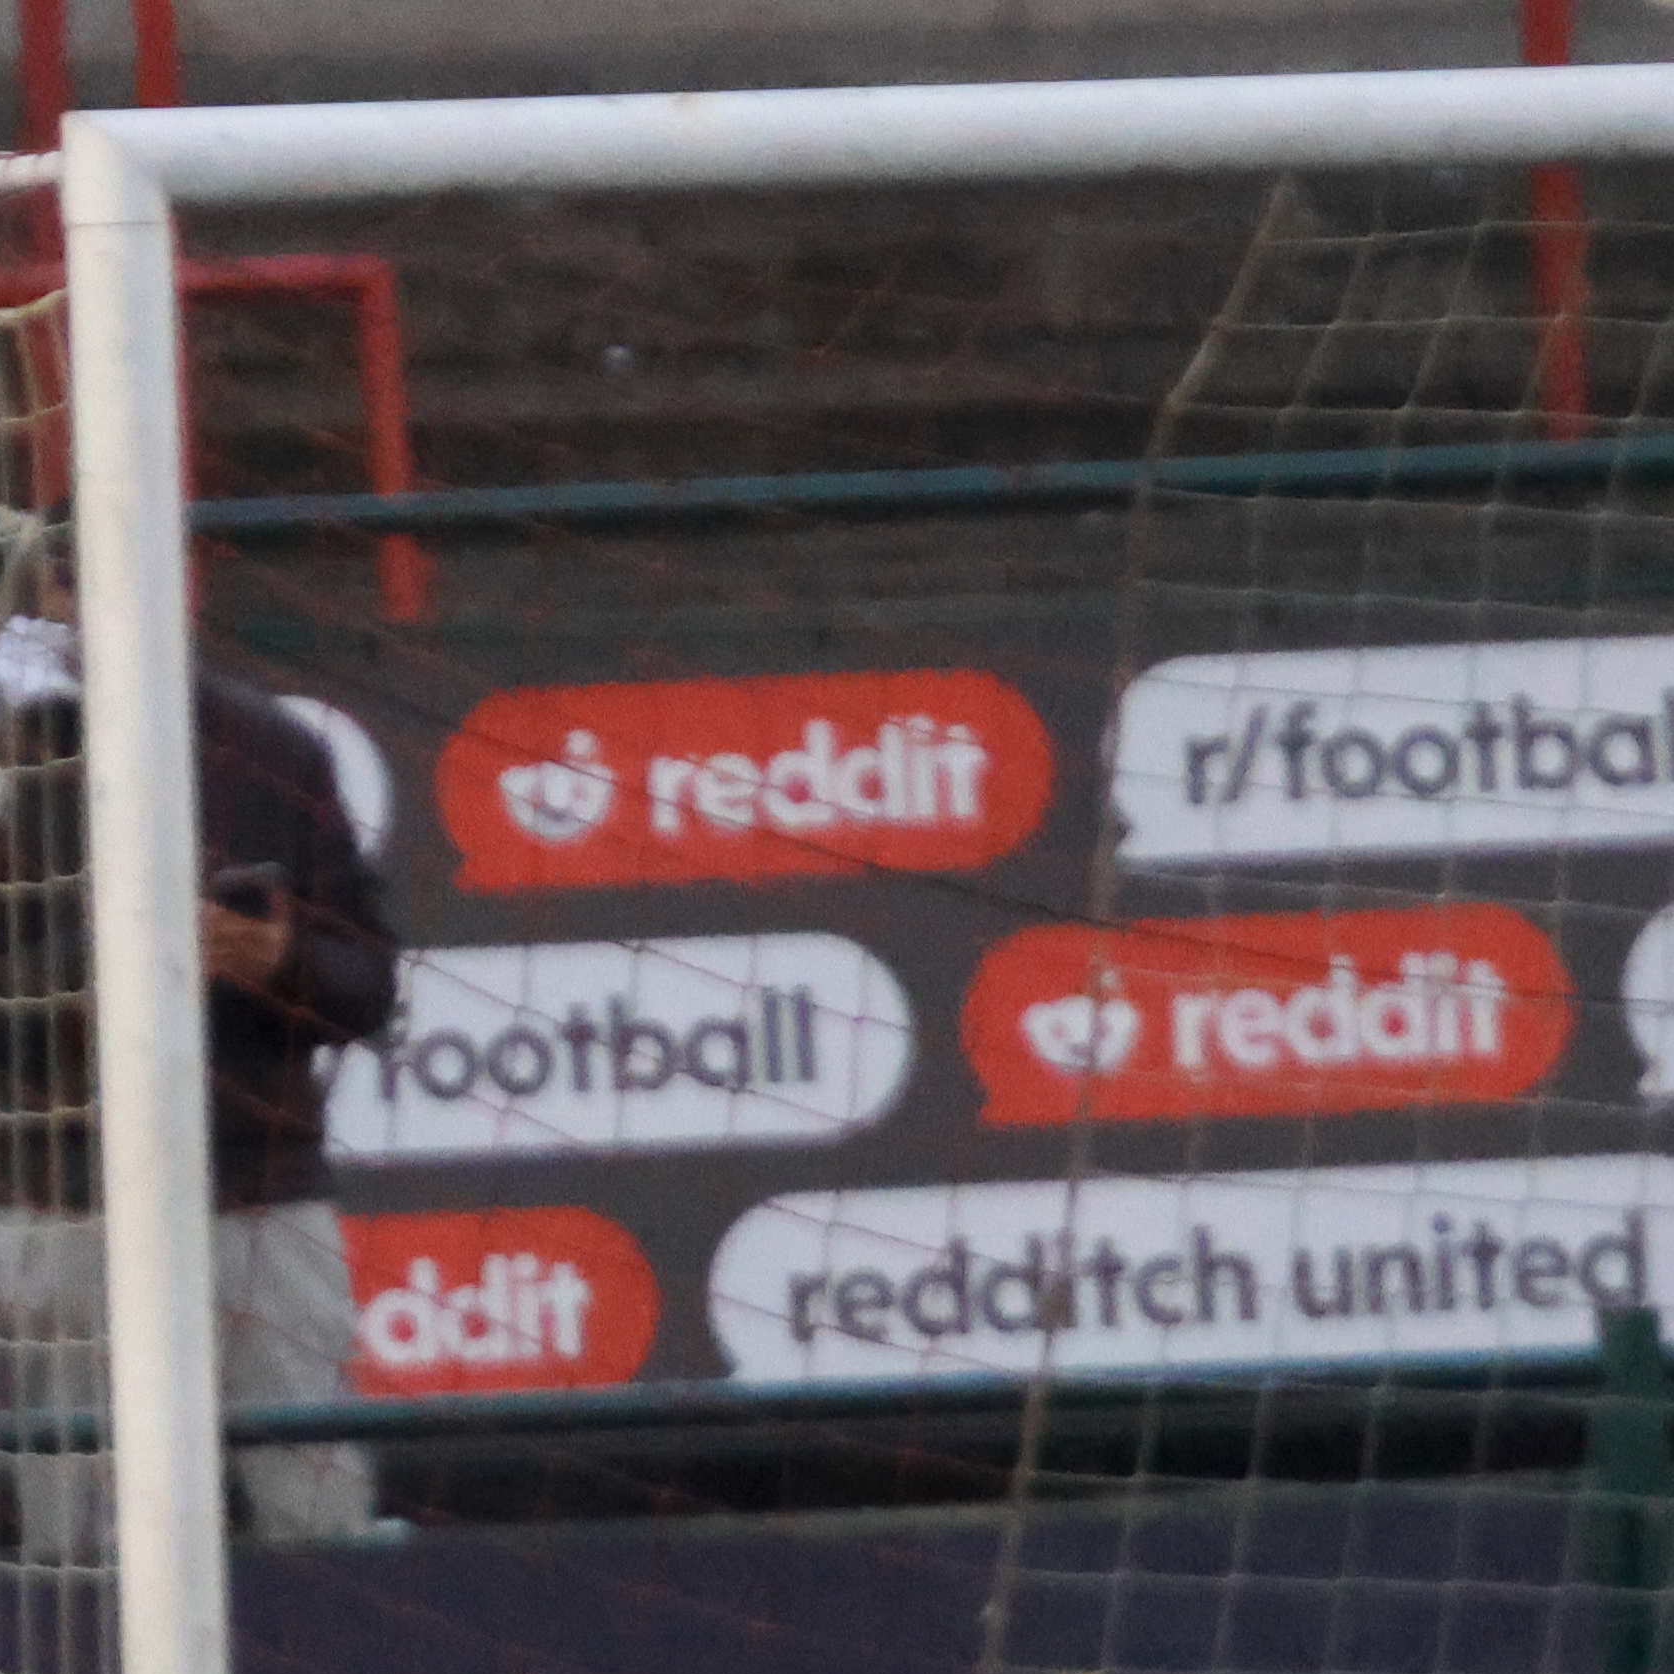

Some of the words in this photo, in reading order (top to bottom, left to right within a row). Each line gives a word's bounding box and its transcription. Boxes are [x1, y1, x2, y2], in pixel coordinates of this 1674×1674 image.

[649, 714, 985, 835] reddit
[1171, 952, 1509, 1070] reddit
[359, 1252, 594, 1366] ddit
[788, 1225, 1259, 1343] redditch
[1293, 1212, 1647, 1320] united
